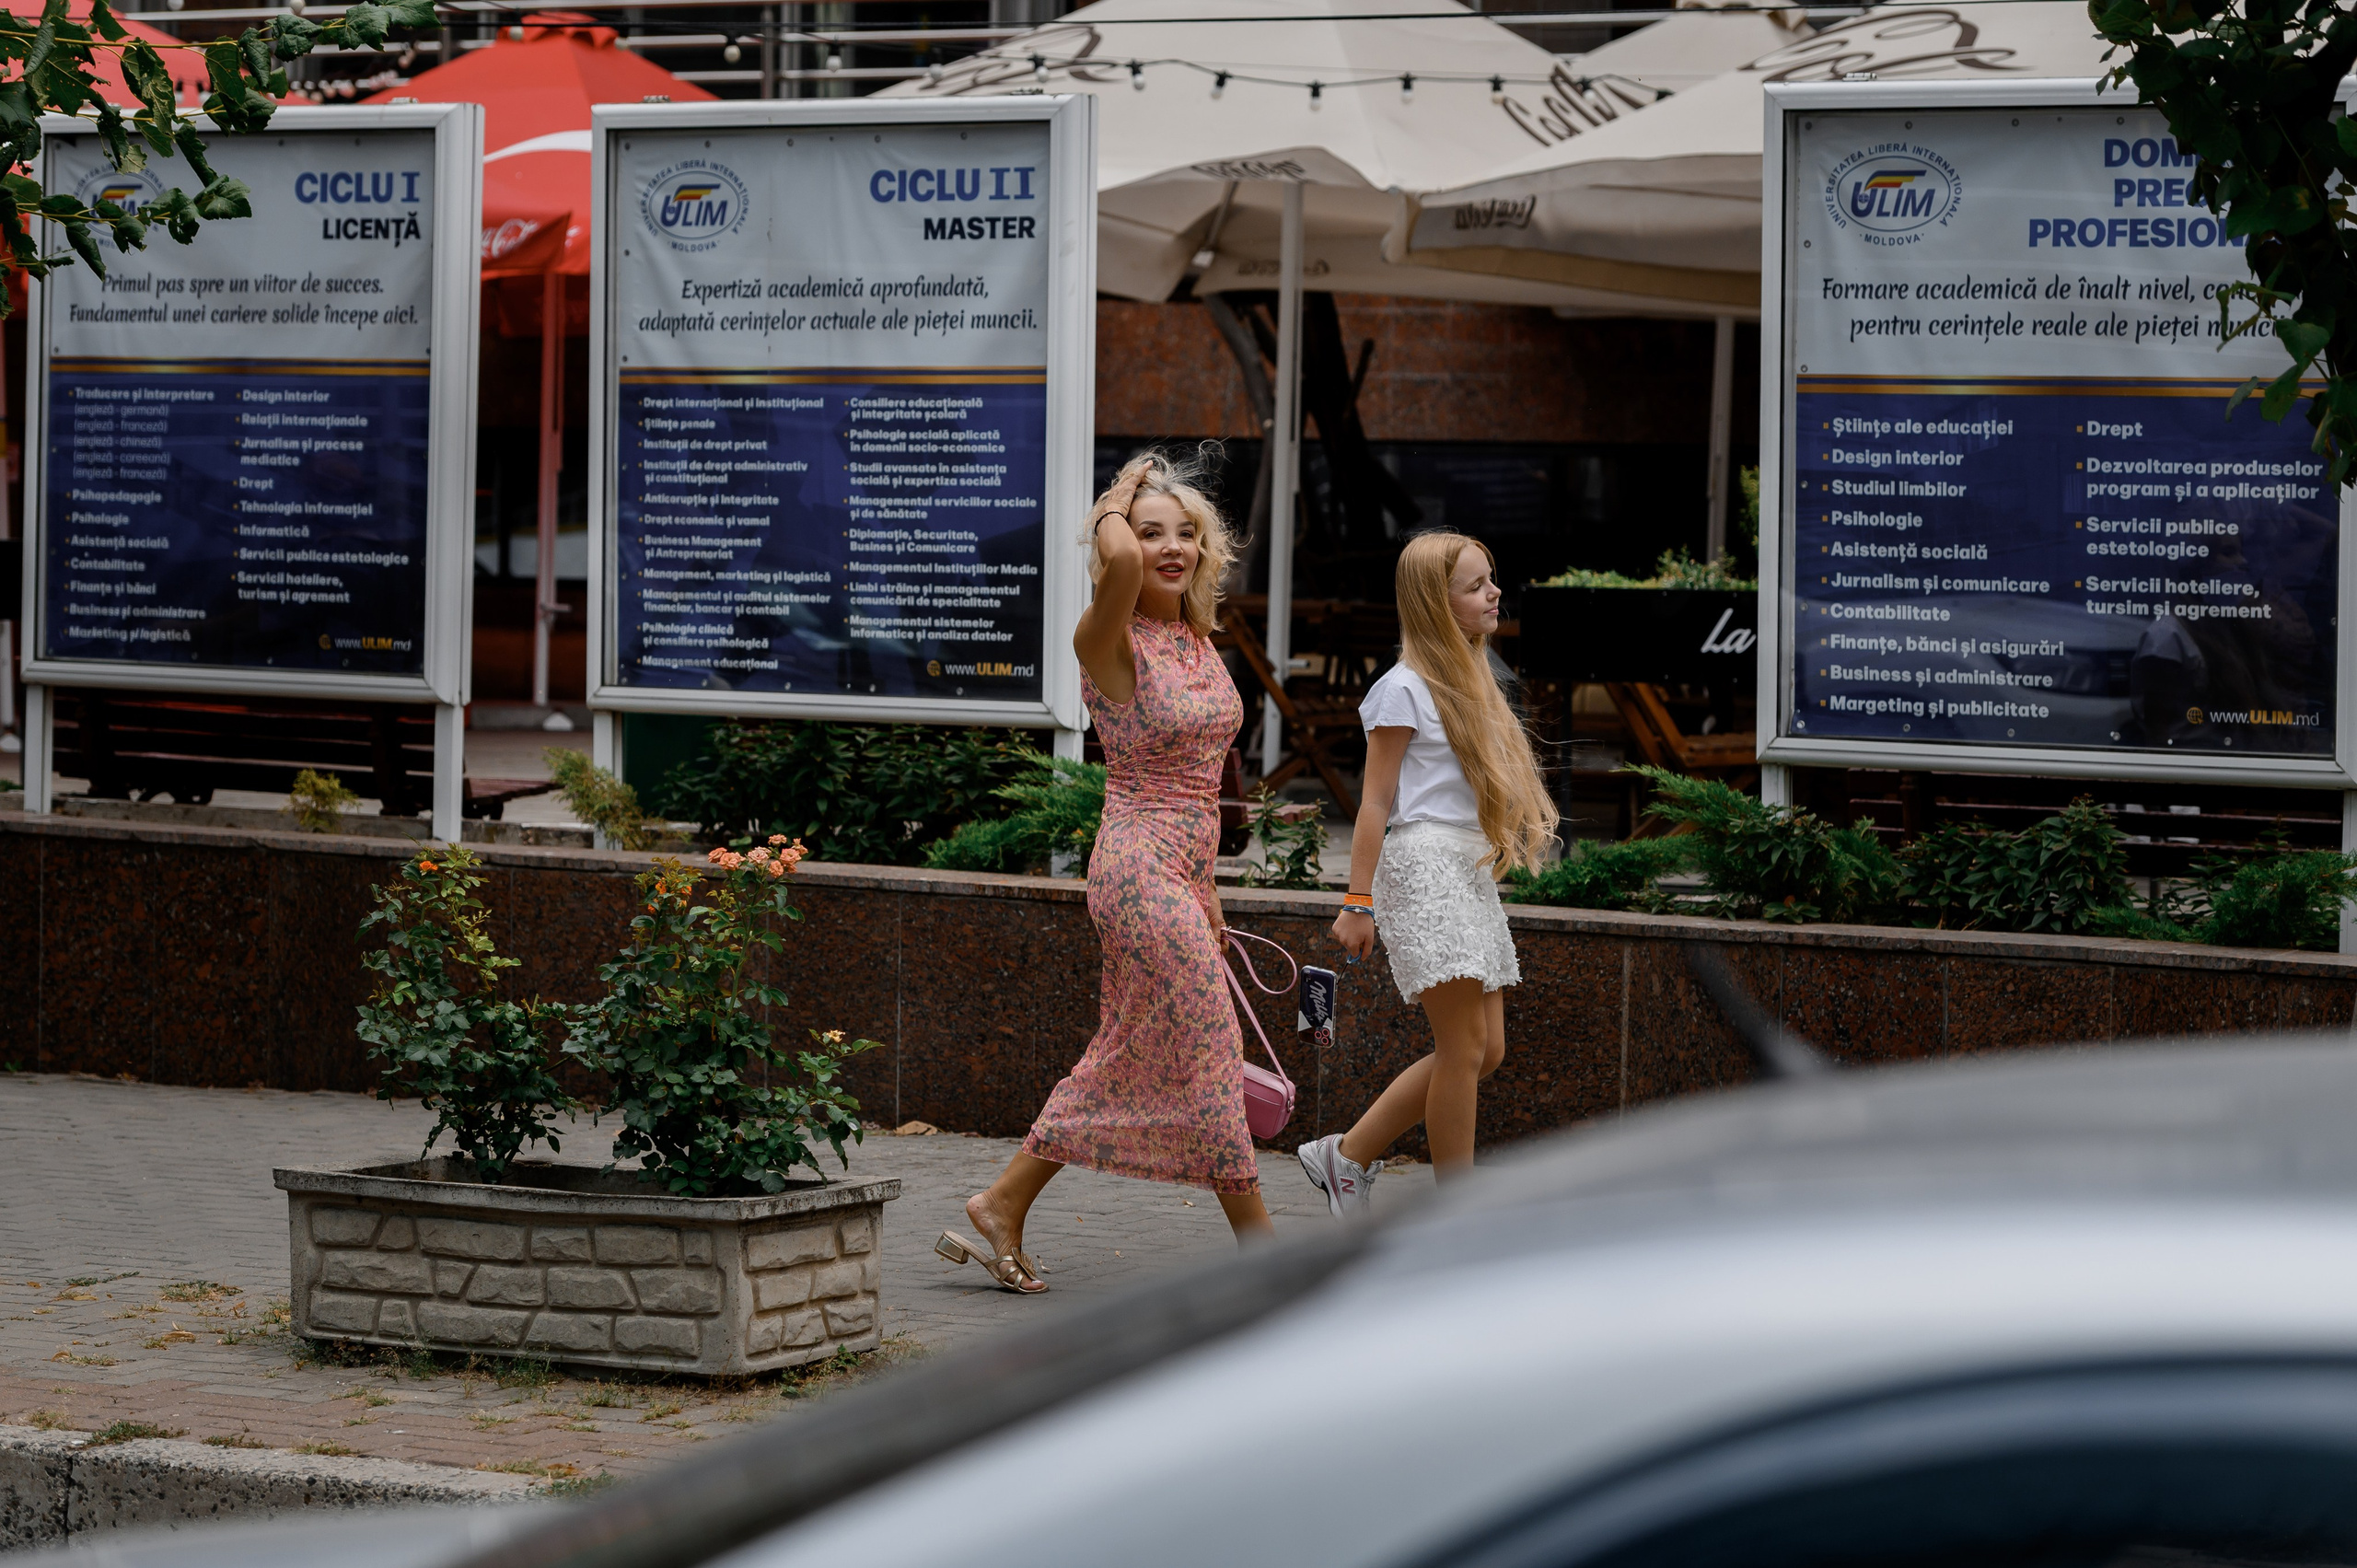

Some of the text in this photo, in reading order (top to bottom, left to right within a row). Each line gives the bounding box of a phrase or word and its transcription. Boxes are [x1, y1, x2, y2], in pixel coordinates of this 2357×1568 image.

[296, 171, 421, 204] CICLU I
[869, 167, 1035, 203] CICLU II
[1826, 151, 1864, 228] UNIVERSITATEA
[1852, 181, 1935, 217] ULIM
[661, 195, 727, 226] ULIM
[323, 211, 421, 248] LICENȚĂ
[923, 216, 1035, 240] MASTER
[1864, 234, 1920, 246] MOLDOVA
[101, 272, 384, 299] Primul pas spre un viitor de succes.
[681, 275, 989, 305] Expertiză academică aprofundată,
[1822, 276, 1909, 301] Formare
[1915, 274, 2037, 300] academică
[2045, 274, 2072, 300] de
[2079, 275, 2131, 300] înalt
[2138, 275, 2195, 303] nivel,
[70, 303, 418, 330] Fundamentul unei cariere solide începe aici.
[639, 308, 1038, 337] adaptată cerințelor actuale ale pieței muncii.
[1851, 314, 1921, 342] pentru
[1928, 310, 2023, 345] cerințele
[2032, 311, 2074, 336] reale
[2095, 313, 2127, 337] ale
[2134, 316, 2200, 344] pieței
[243, 389, 330, 404] Design interior
[644, 397, 673, 410] Drept
[850, 397, 906, 408] Consiliere
[850, 430, 906, 441] Psihologie
[1833, 417, 2013, 440] Științe ale educației
[2087, 421, 2142, 439] Drept
[241, 437, 299, 449] Jurnalism
[863, 442, 906, 452] domenii
[909, 443, 1005, 452] socio-economice
[850, 462, 882, 473] Studii
[885, 464, 936, 473] avansate
[1832, 449, 1964, 468] Design interior
[2086, 458, 2323, 478] Dezvoltarea produselor
[239, 477, 273, 491] Drept
[1832, 480, 1967, 496] Studiul limbilor
[2086, 482, 2319, 505] program și a aplicaților
[850, 496, 1037, 507] Managementul serviciilor sociale
[1831, 511, 1922, 530] Psihologie
[2086, 517, 2239, 537] Servicii publice
[644, 535, 761, 548] Business Management
[914, 529, 978, 541] Securitate,
[286, 549, 330, 563] publice
[1831, 541, 1988, 563] Asistență socială
[2086, 541, 2209, 561] estetologice
[71, 558, 145, 571] Contabilitate
[850, 562, 932, 574] Managementul
[1001, 564, 1038, 575] Media
[644, 568, 714, 581] Management,
[716, 571, 771, 582] marketing
[1831, 573, 2049, 595] Jurnalism și comunicare
[850, 584, 877, 593] Limbi
[935, 586, 1019, 596] managementul
[2085, 575, 2259, 598] Servicii hoteliere,
[1830, 603, 1950, 621] Contabilitate
[2086, 599, 2271, 621] tursim și agrement
[850, 615, 994, 628] Managementul sistemelor
[1701, 608, 1756, 654] La
[335, 637, 412, 651] www.ULIM.md
[1830, 634, 2063, 658] Finanțe, bănci și asigurări
[643, 656, 711, 668] Management
[946, 663, 1034, 677] www.ULIM.md
[1830, 665, 2053, 688] Business și administrare
[1830, 695, 2049, 719] Margeting și publicitate
[2211, 709, 2319, 726] www.ULIM.md
